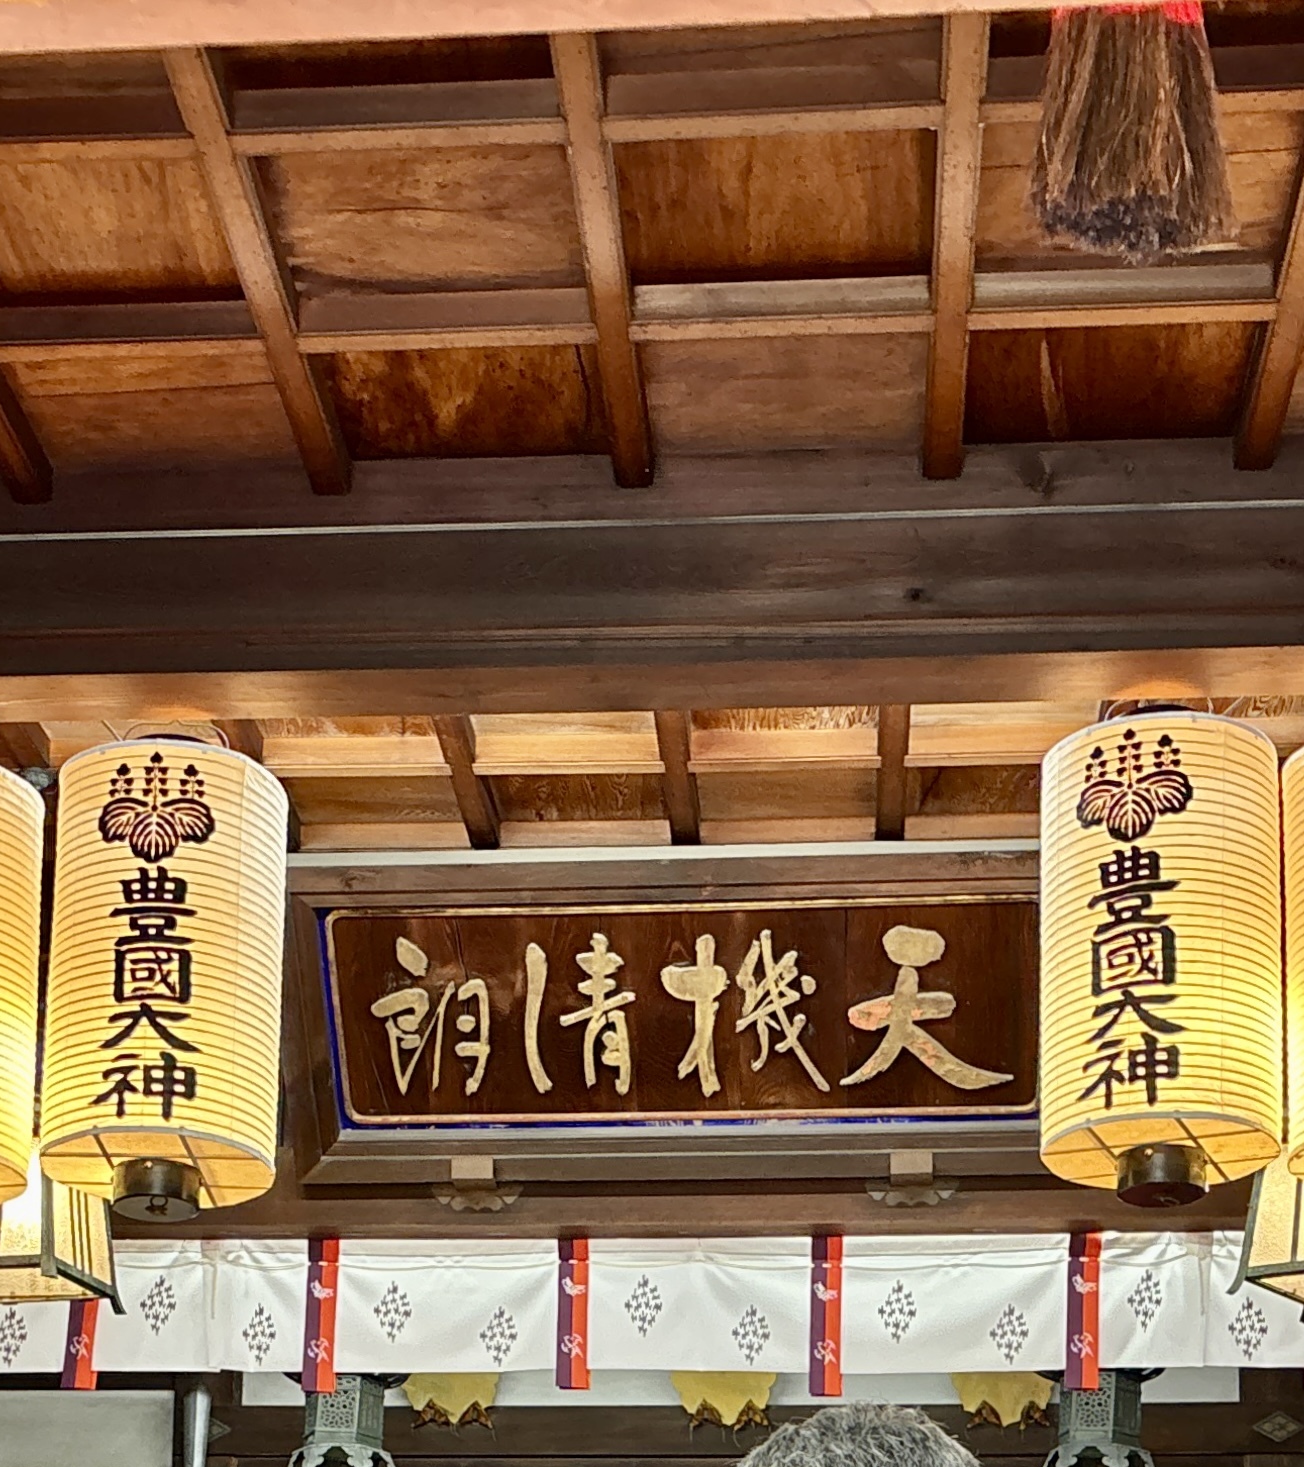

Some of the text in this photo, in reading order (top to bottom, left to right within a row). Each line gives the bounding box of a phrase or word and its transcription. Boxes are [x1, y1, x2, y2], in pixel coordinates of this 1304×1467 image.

[88, 866, 197, 1121] 豊國大神
[1075, 845, 1187, 1109] 豊國大神
